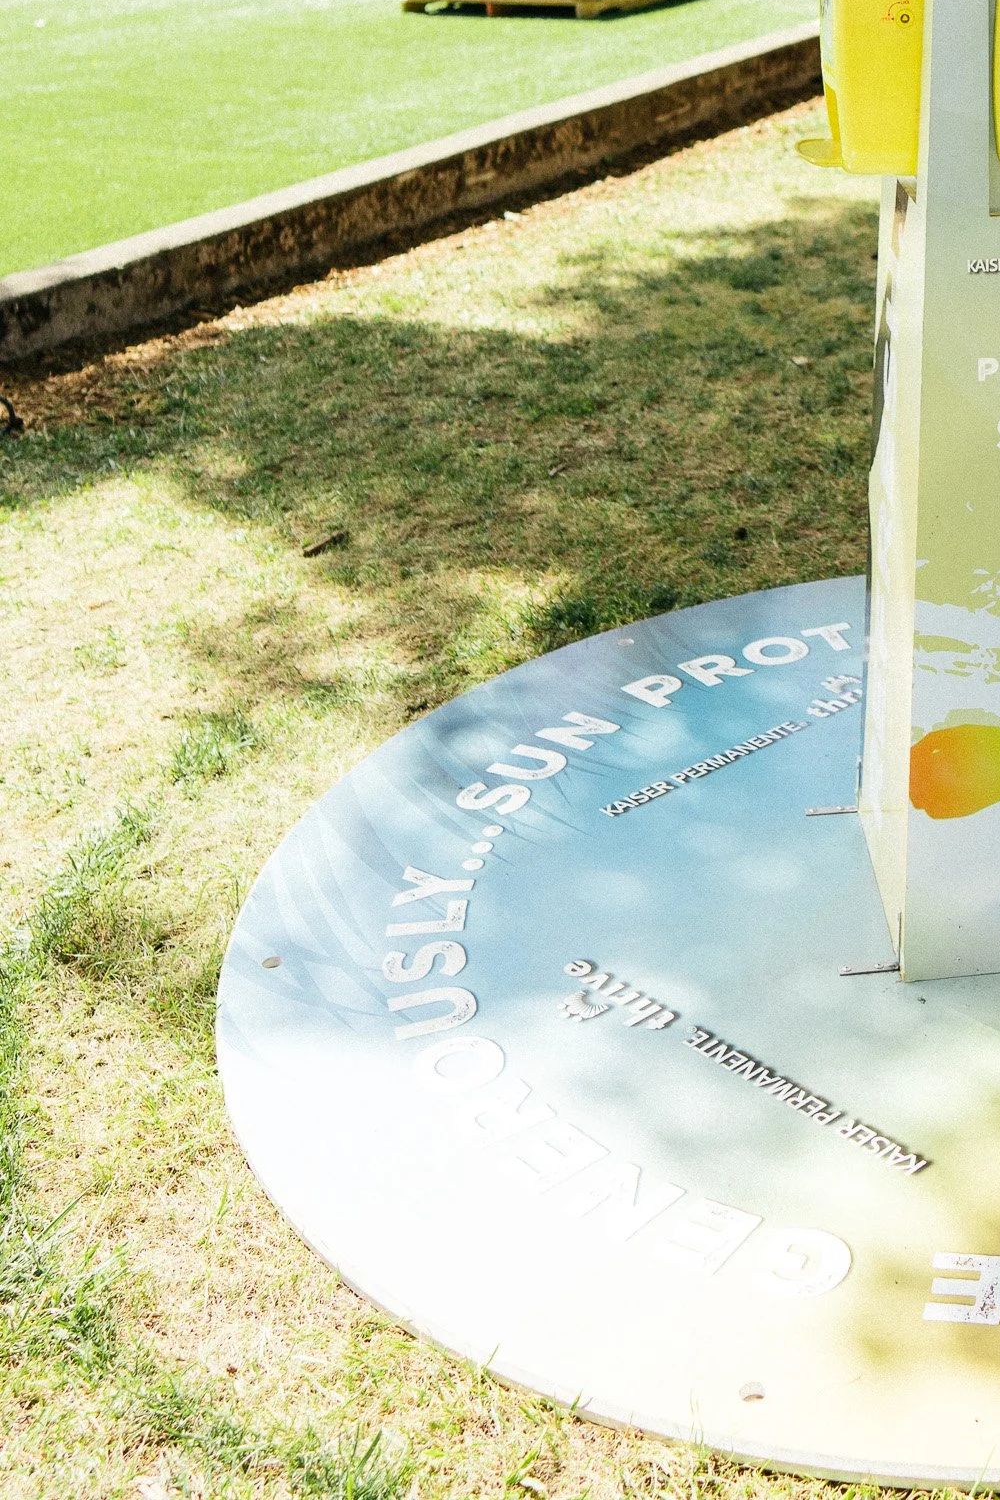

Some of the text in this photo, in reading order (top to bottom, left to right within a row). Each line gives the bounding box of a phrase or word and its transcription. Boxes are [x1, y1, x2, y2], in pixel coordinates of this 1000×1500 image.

[455, 709, 622, 817] SUN
[600, 780, 675, 817] KAISER
[563, 958, 679, 1031] thrive
[839, 1118, 929, 1176] KAISER
